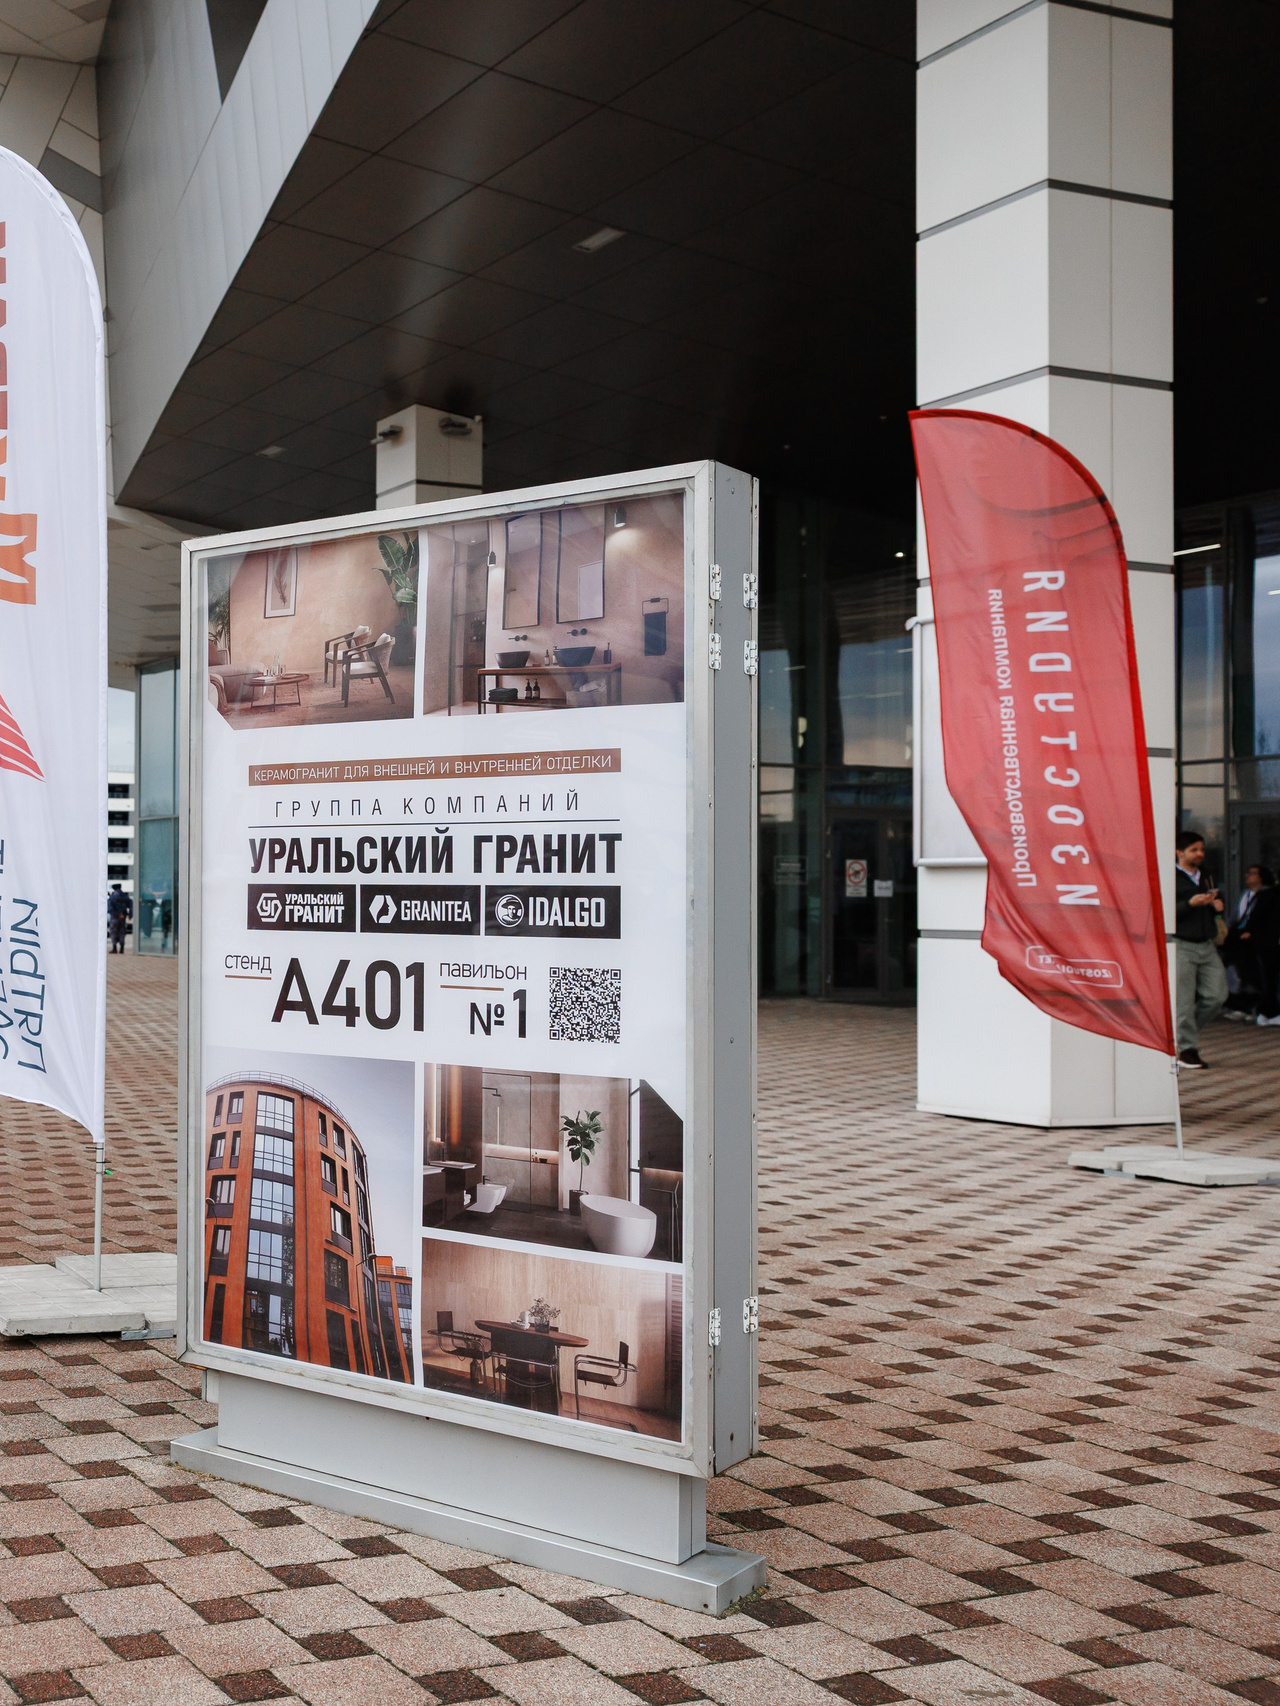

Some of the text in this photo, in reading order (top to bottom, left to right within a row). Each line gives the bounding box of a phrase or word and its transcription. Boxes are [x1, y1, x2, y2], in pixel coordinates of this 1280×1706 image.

[254, 755, 612, 781] КЕРАМОГРАНИТ ДЛЯ ВНЕШНЕЙ И ВНУТРЕННЕЙ ОТДЕЛКИ
[275, 789, 579, 818] ГРУППА КОМПАНИЙ
[249, 827, 622, 874] УРАЛЬСКИЙ ГРАНИТ
[285, 892, 344, 905] УРАЛЬСКИЙ
[285, 905, 345, 924] ГРАНИТ
[401, 900, 472, 922] GRANITEA
[528, 896, 606, 927] IDALGO
[224, 953, 272, 974] стенд
[440, 961, 528, 981] павильон
